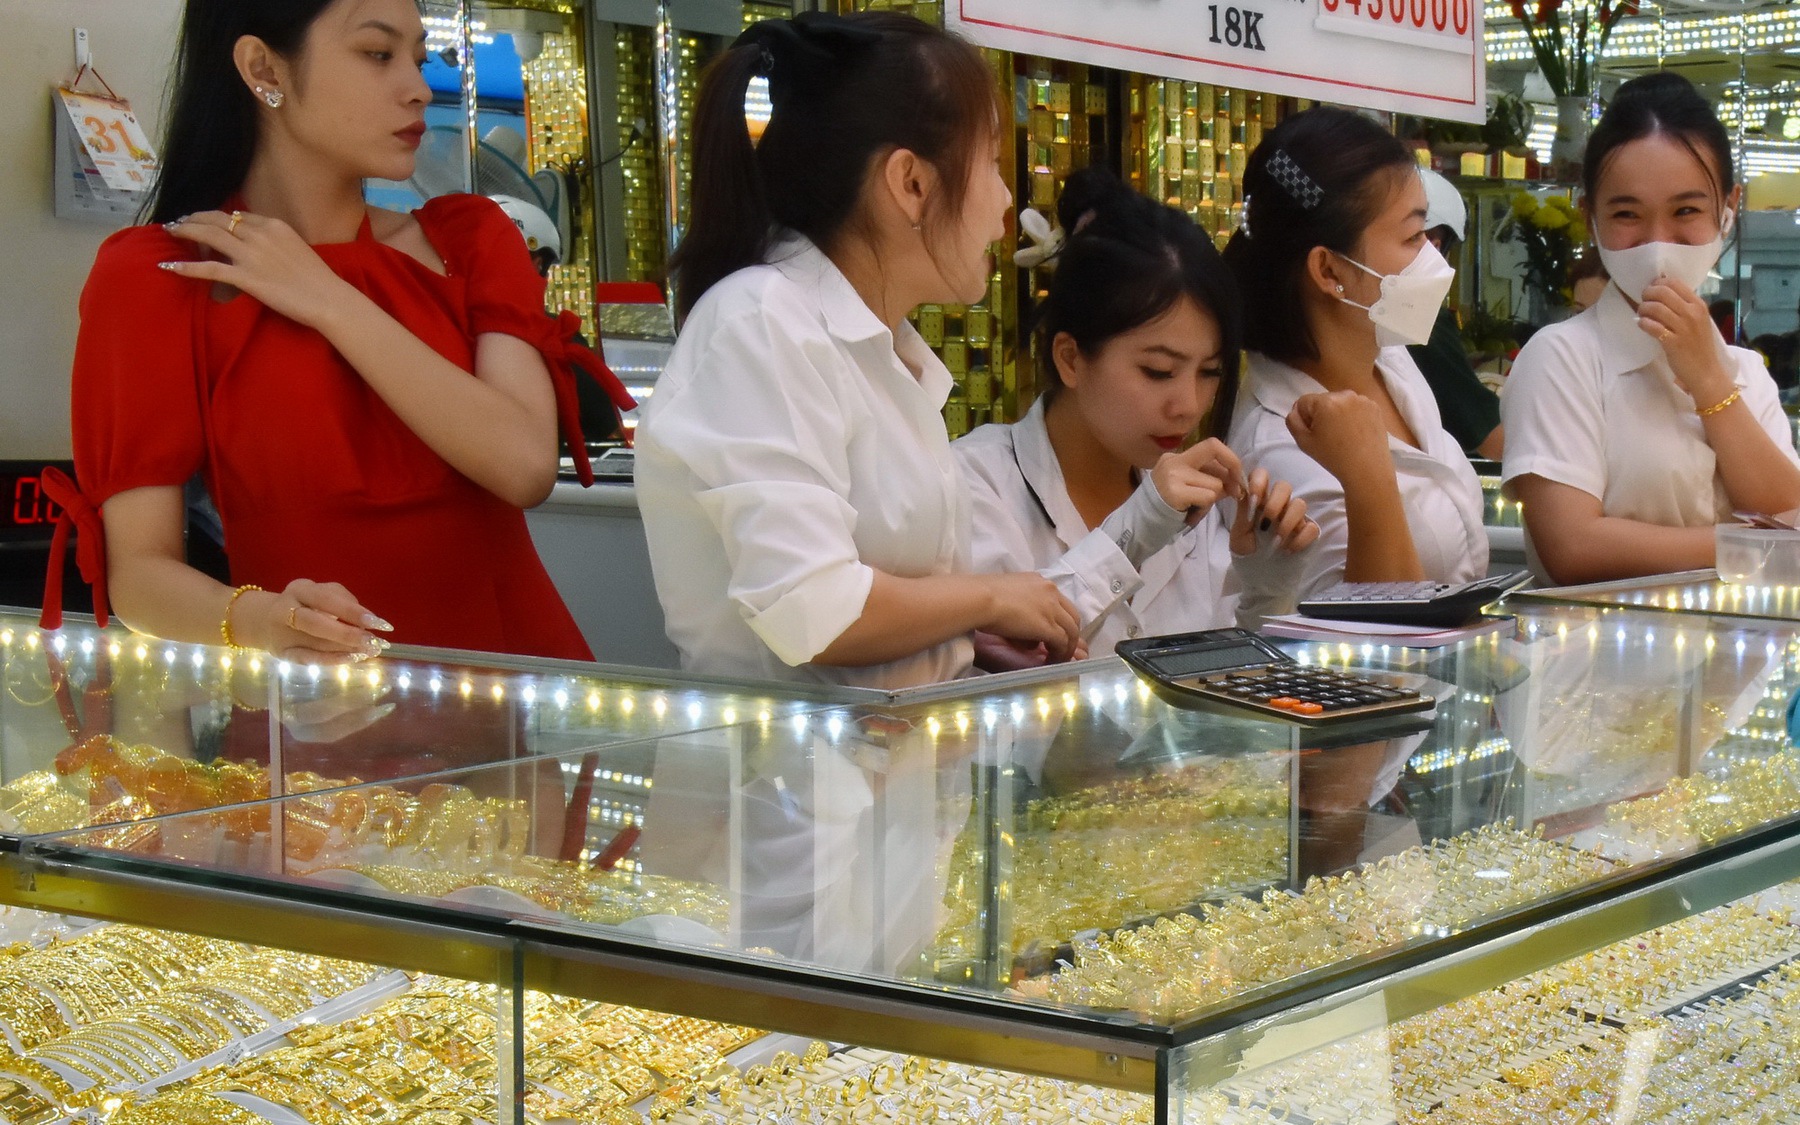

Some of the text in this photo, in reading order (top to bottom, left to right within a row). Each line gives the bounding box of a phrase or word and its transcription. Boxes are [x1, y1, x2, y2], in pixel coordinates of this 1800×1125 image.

[1208, 4, 1266, 51] 18K
[1323, 0, 1469, 35] 0000
[84, 116, 138, 160] 31
